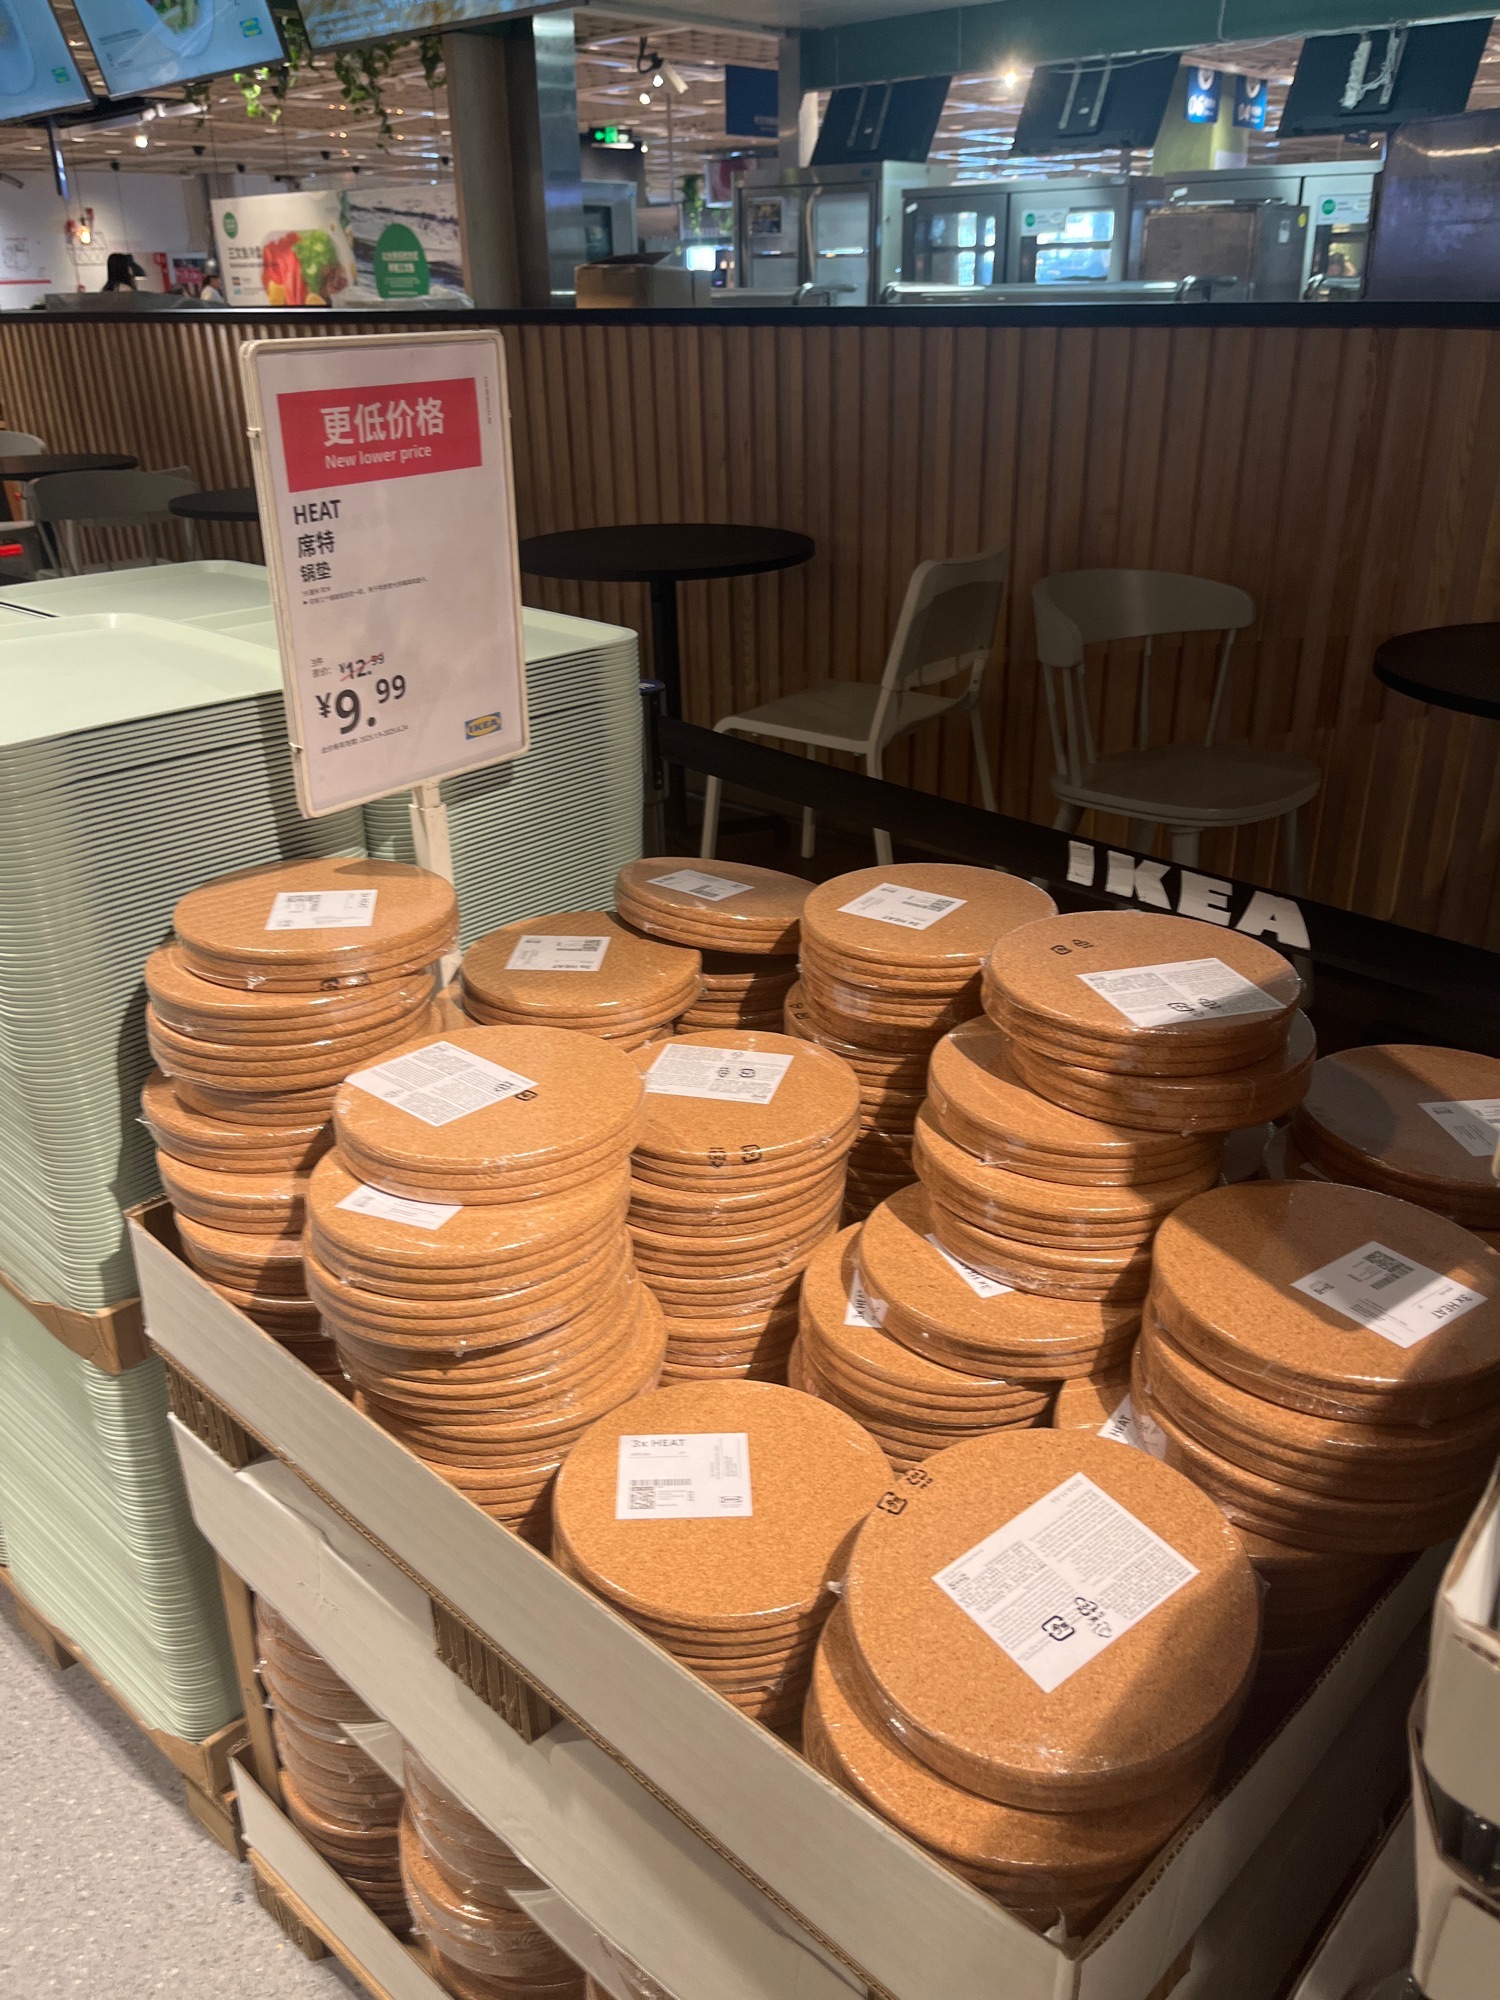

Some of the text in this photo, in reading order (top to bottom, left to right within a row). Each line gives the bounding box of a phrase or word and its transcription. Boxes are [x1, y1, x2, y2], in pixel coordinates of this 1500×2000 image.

[320, 397, 445, 447] 更低价格
[324, 443, 432, 470] New lower price
[293, 499, 341, 525] HEAT
[297, 530, 335, 558] 席特
[300, 561, 332, 582] 锅垫
[1066, 840, 1312, 951] IKEA
[1431, 1293, 1473, 1320] 3x HEAT
[1108, 1414, 1132, 1438] HEAT
[630, 1438, 687, 1448] 3x HEAT
